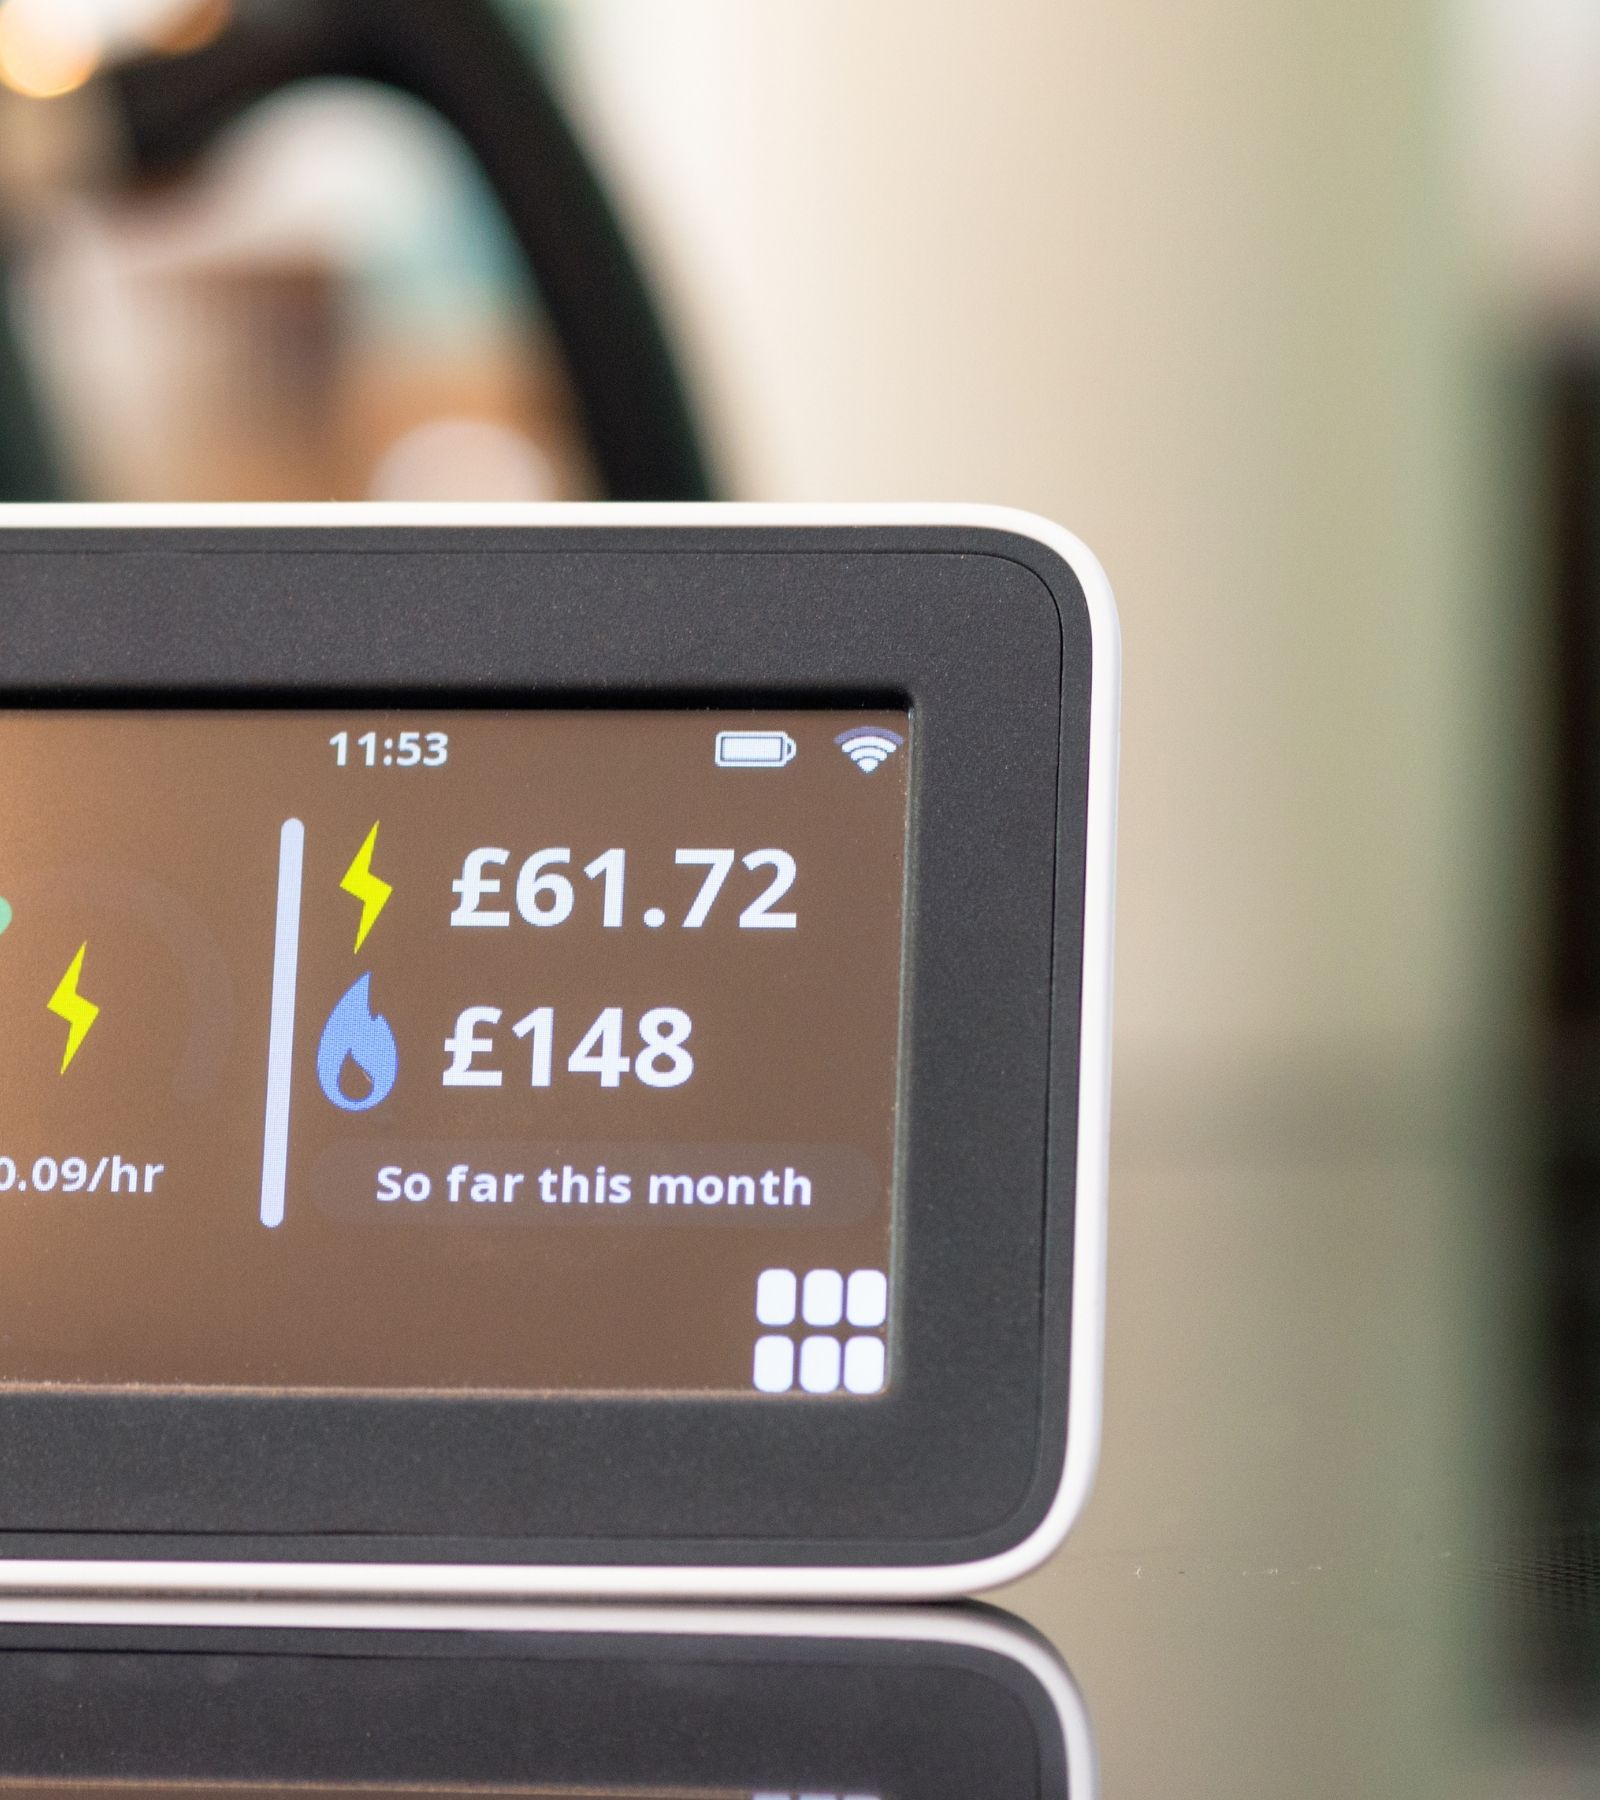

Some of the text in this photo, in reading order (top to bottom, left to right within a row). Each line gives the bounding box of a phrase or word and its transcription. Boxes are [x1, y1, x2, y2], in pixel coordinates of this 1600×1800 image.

[328, 730, 450, 768] 11:53
[449, 846, 798, 929] £61.72
[442, 1005, 695, 1088] £148
[375, 1163, 812, 1207] So far this month
